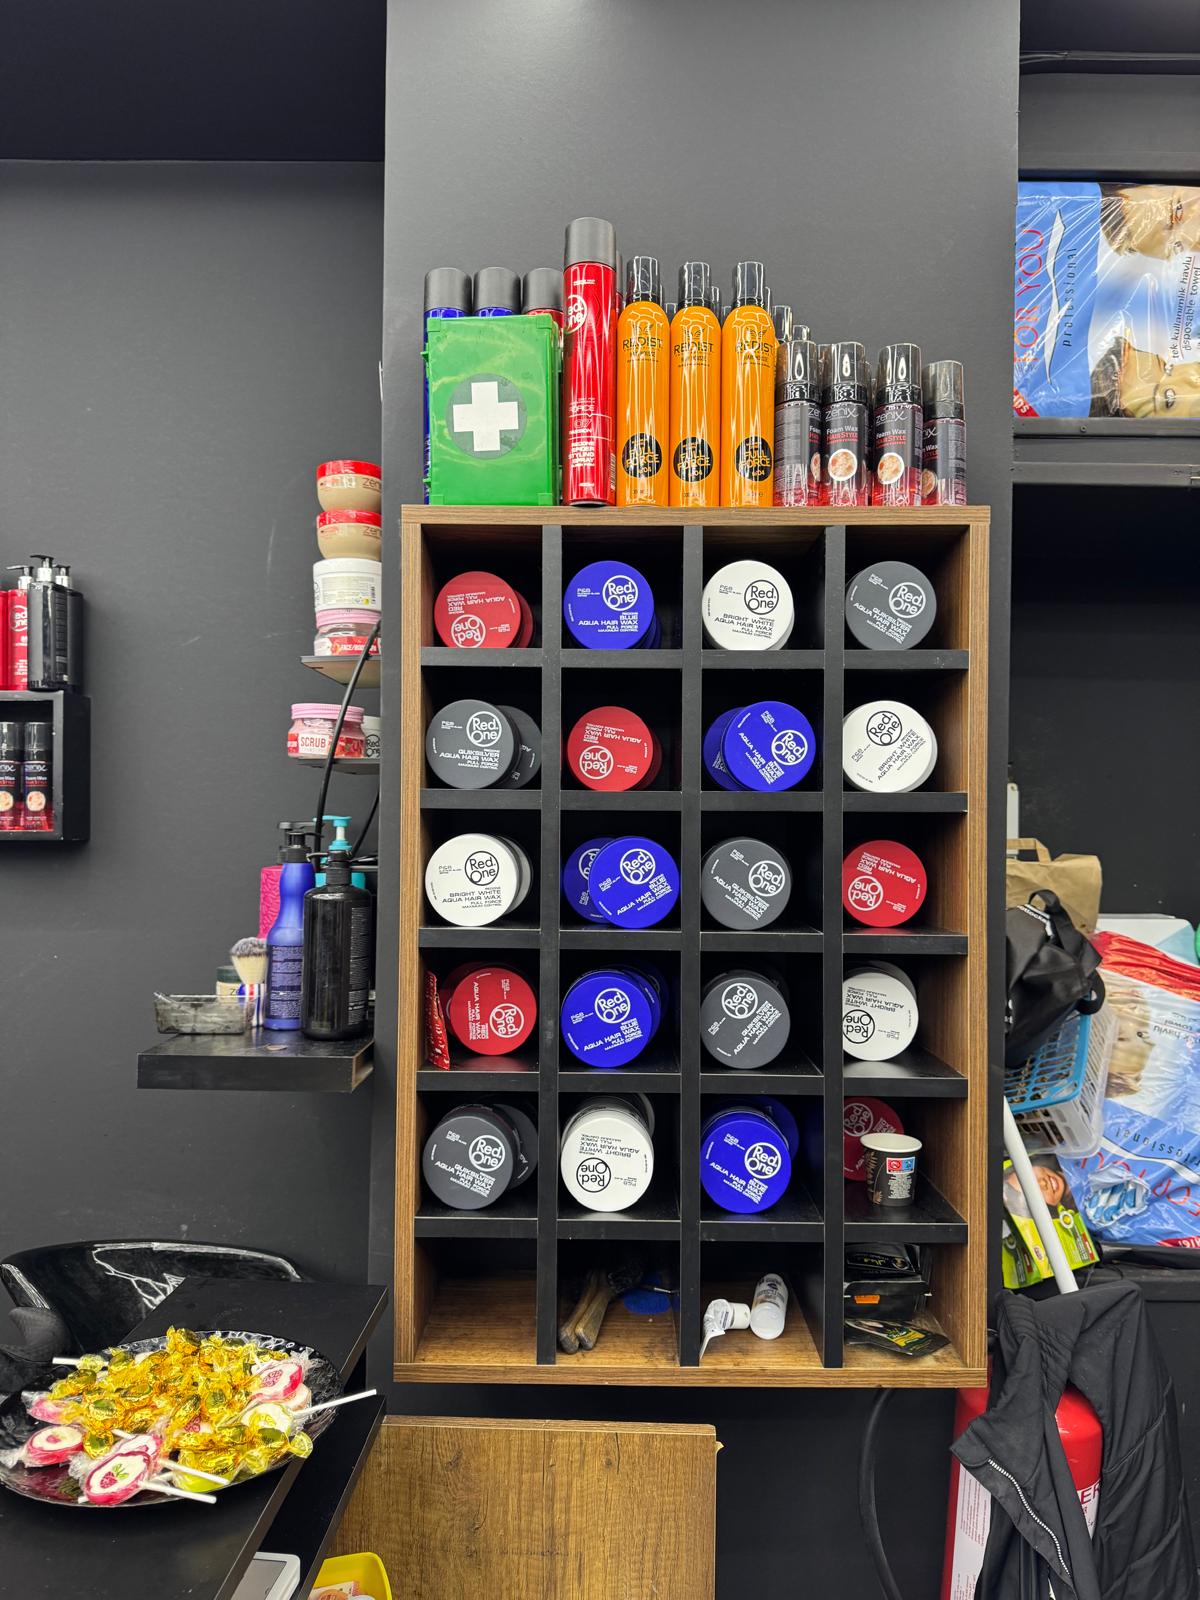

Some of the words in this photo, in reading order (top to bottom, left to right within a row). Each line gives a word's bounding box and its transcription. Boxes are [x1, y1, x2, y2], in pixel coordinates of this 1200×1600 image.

[1016, 229, 1044, 297] YOU
[1062, 248, 1077, 347] professional
[1170, 343, 1180, 359] tek
[1181, 256, 1193, 284] havlu
[826, 407, 859, 420] zenix
[876, 410, 908, 424] zenix
[608, 594, 635, 609] One
[748, 598, 774, 614] One
[890, 599, 918, 615] One
[454, 616, 480, 631] One
[714, 617, 735, 625] AQUA
[755, 624, 773, 632] WAX
[723, 613, 749, 622] BRIGHT
[751, 618, 774, 627] WHITE
[854, 602, 873, 617] AQUA
[873, 614, 891, 627] HAIR
[890, 624, 908, 637] WAX
[873, 607, 911, 632] QUIKSILVER
[471, 730, 497, 743] One
[880, 720, 899, 744] One
[300, 736, 326, 748] SCRUB
[459, 749, 499, 757] QUIKSILVER
[584, 749, 609, 762] One
[774, 742, 796, 763] One
[859, 859, 877, 869] WAX
[877, 866, 895, 876] HAIR
[470, 868, 495, 883] One
[630, 862, 653, 882] One
[896, 873, 916, 884] AQUA
[649, 879, 667, 891] BLUE
[751, 876, 776, 894] One
[854, 881, 880, 894] One
[616, 902, 635, 915] AQUA
[635, 893, 652, 905] HAIR
[652, 884, 670, 896] WAX
[713, 876, 733, 892] AQUA
[732, 889, 749, 903] HAIR
[748, 900, 765, 915] WAX
[732, 883, 768, 910] QUIKSILVER
[735, 993, 755, 1017] One
[845, 999, 868, 1007] WHITE
[846, 994, 864, 1002] WAX
[884, 1001, 904, 1009] AQUA
[603, 1002, 628, 1021] One
[870, 1004, 896, 1013] BRIGHT
[493, 1009, 506, 1035] One
[620, 1021, 638, 1031] BLUE
[846, 1014, 871, 1025] One
[583, 1039, 603, 1051] AQUA
[604, 1033, 621, 1043] HAIR
[622, 1026, 640, 1036] WAX
[472, 1152, 498, 1167] One
[605, 1150, 631, 1158] BRIGHT
[581, 1162, 606, 1174] One
[747, 1157, 774, 1175] One
[435, 1161, 456, 1174] AQUA
[456, 1170, 474, 1182] HAIR
[474, 1178, 492, 1190] WAX
[455, 1164, 494, 1185] QUIKSILVER
[749, 1179, 767, 1192] BLUE
